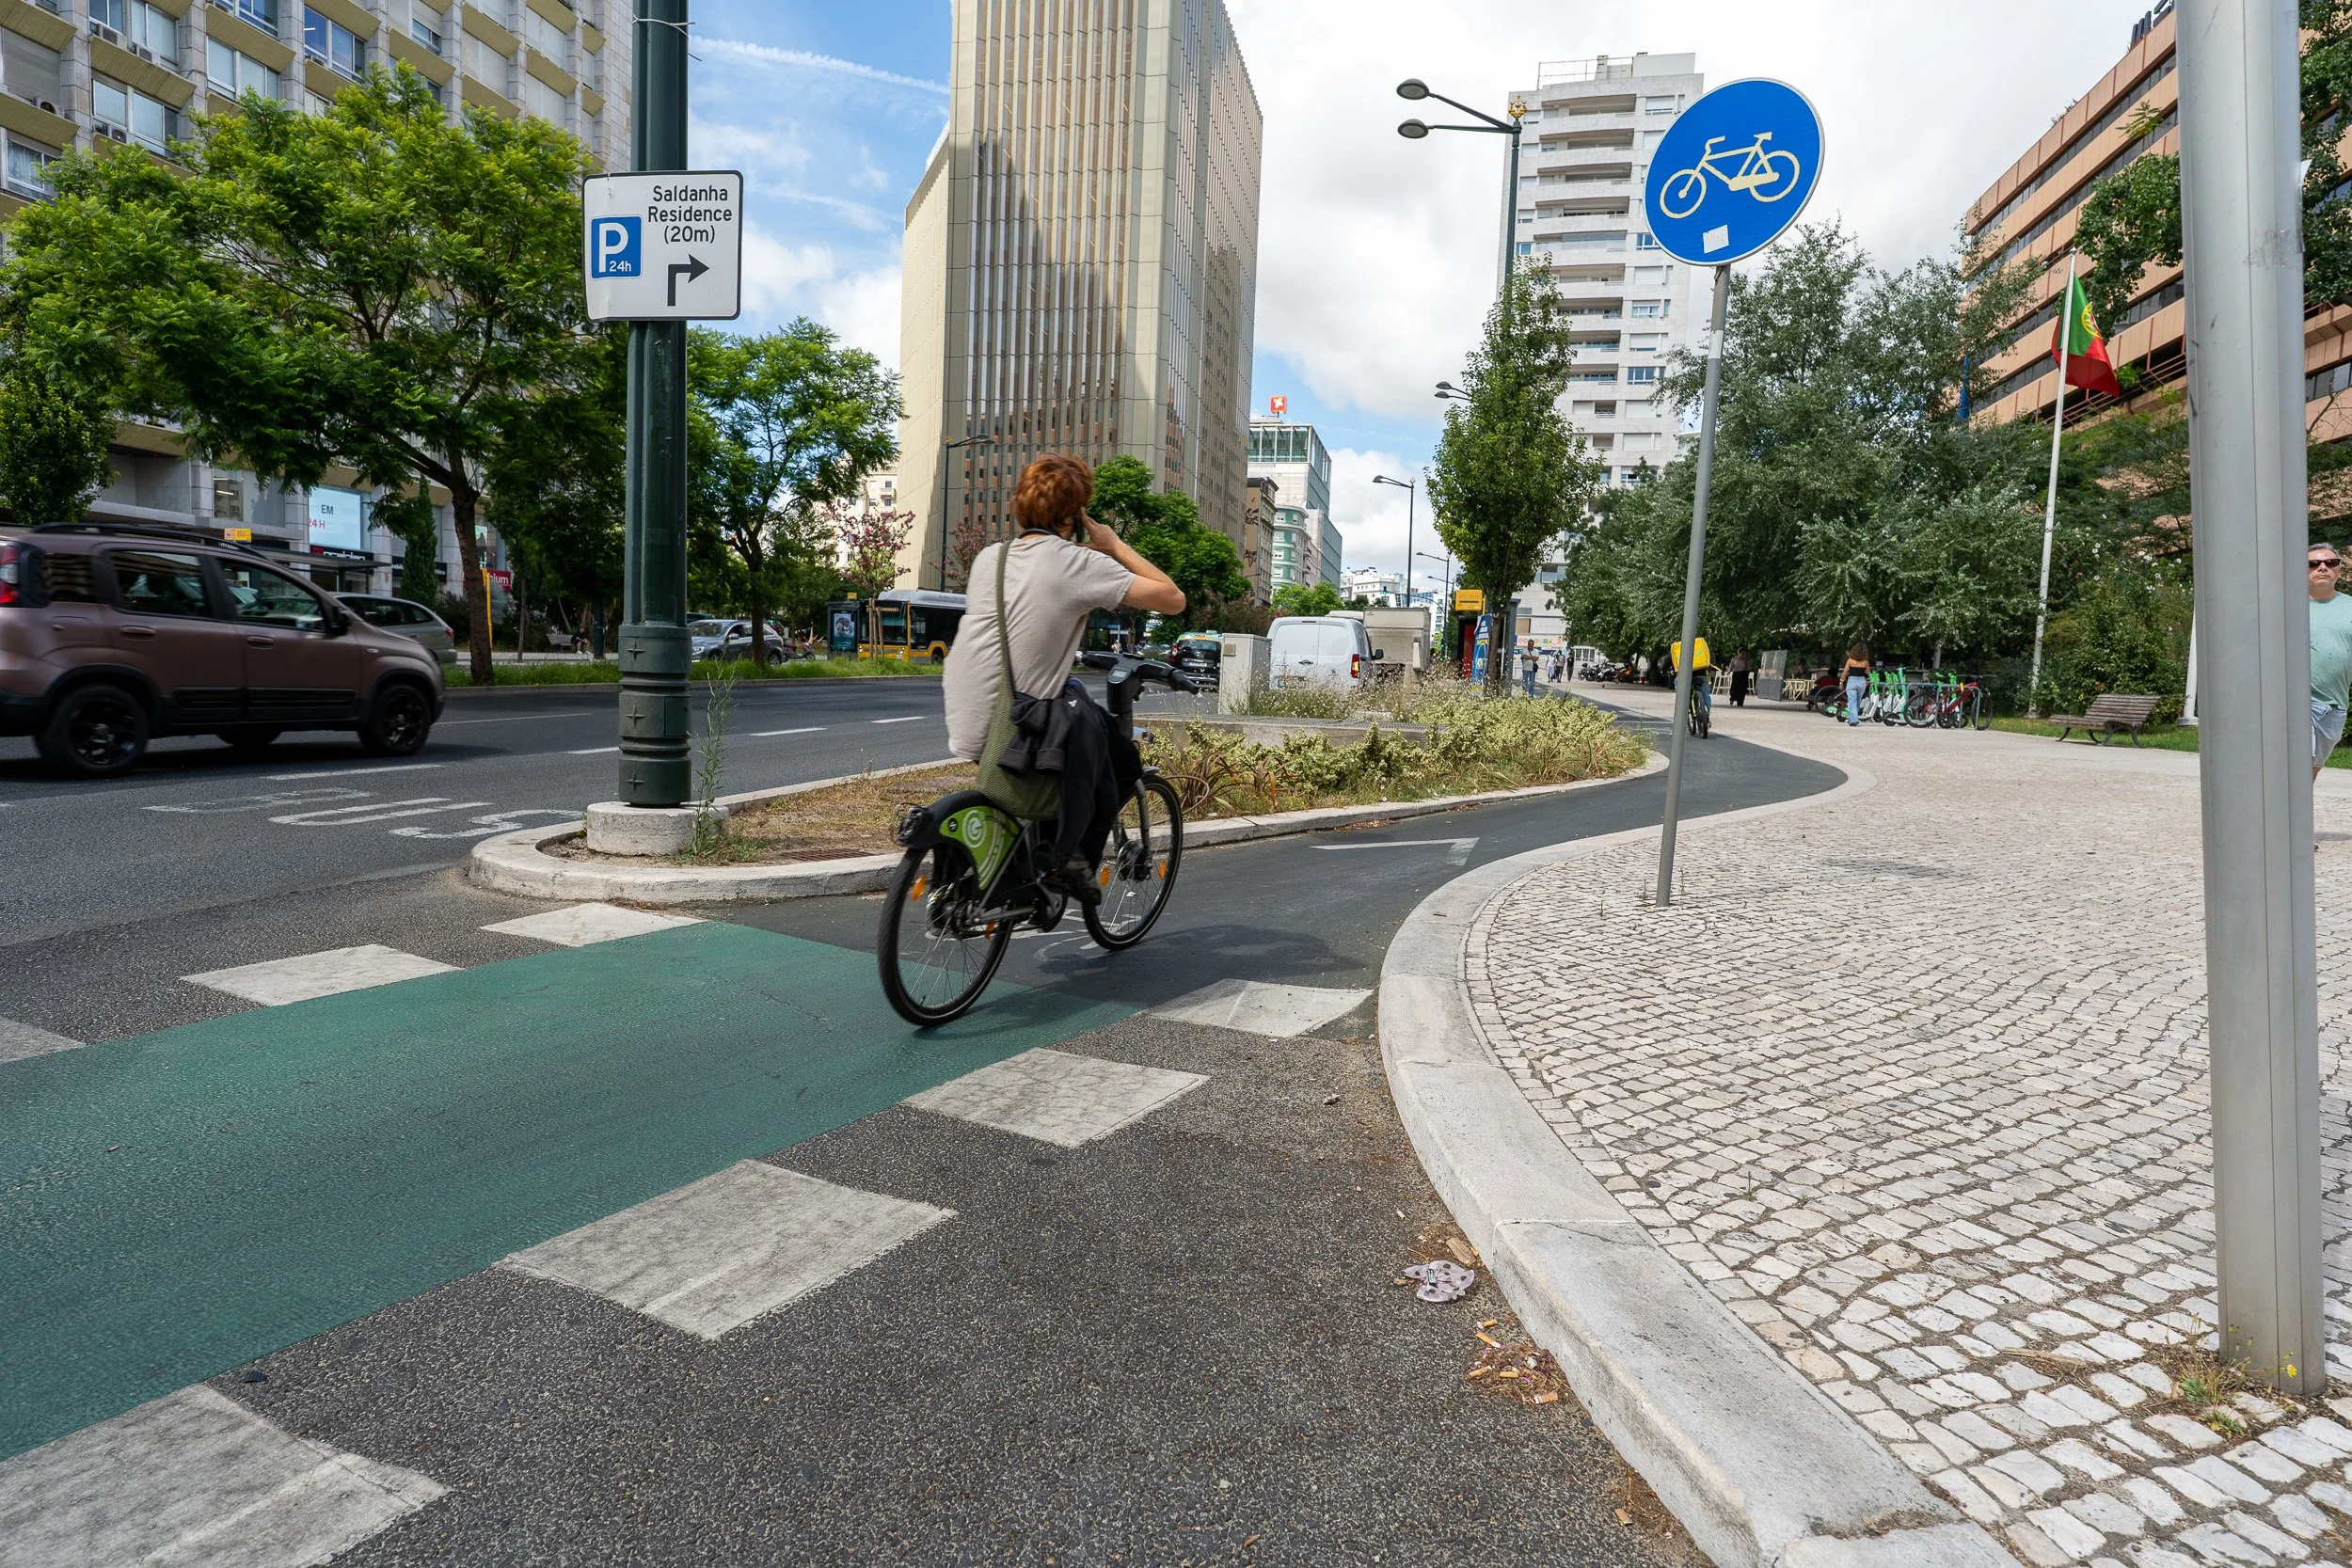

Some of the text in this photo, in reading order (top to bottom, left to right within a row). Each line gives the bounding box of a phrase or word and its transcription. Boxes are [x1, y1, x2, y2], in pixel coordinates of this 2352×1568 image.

[653, 184, 728, 202] Saldanha
[647, 205, 732, 223] Residence
[663, 225, 716, 245] (20m)
[598, 222, 628, 273] P
[609, 261, 632, 272] 24h
[319, 520, 326, 530] H
[140, 786, 585, 840] BUS
